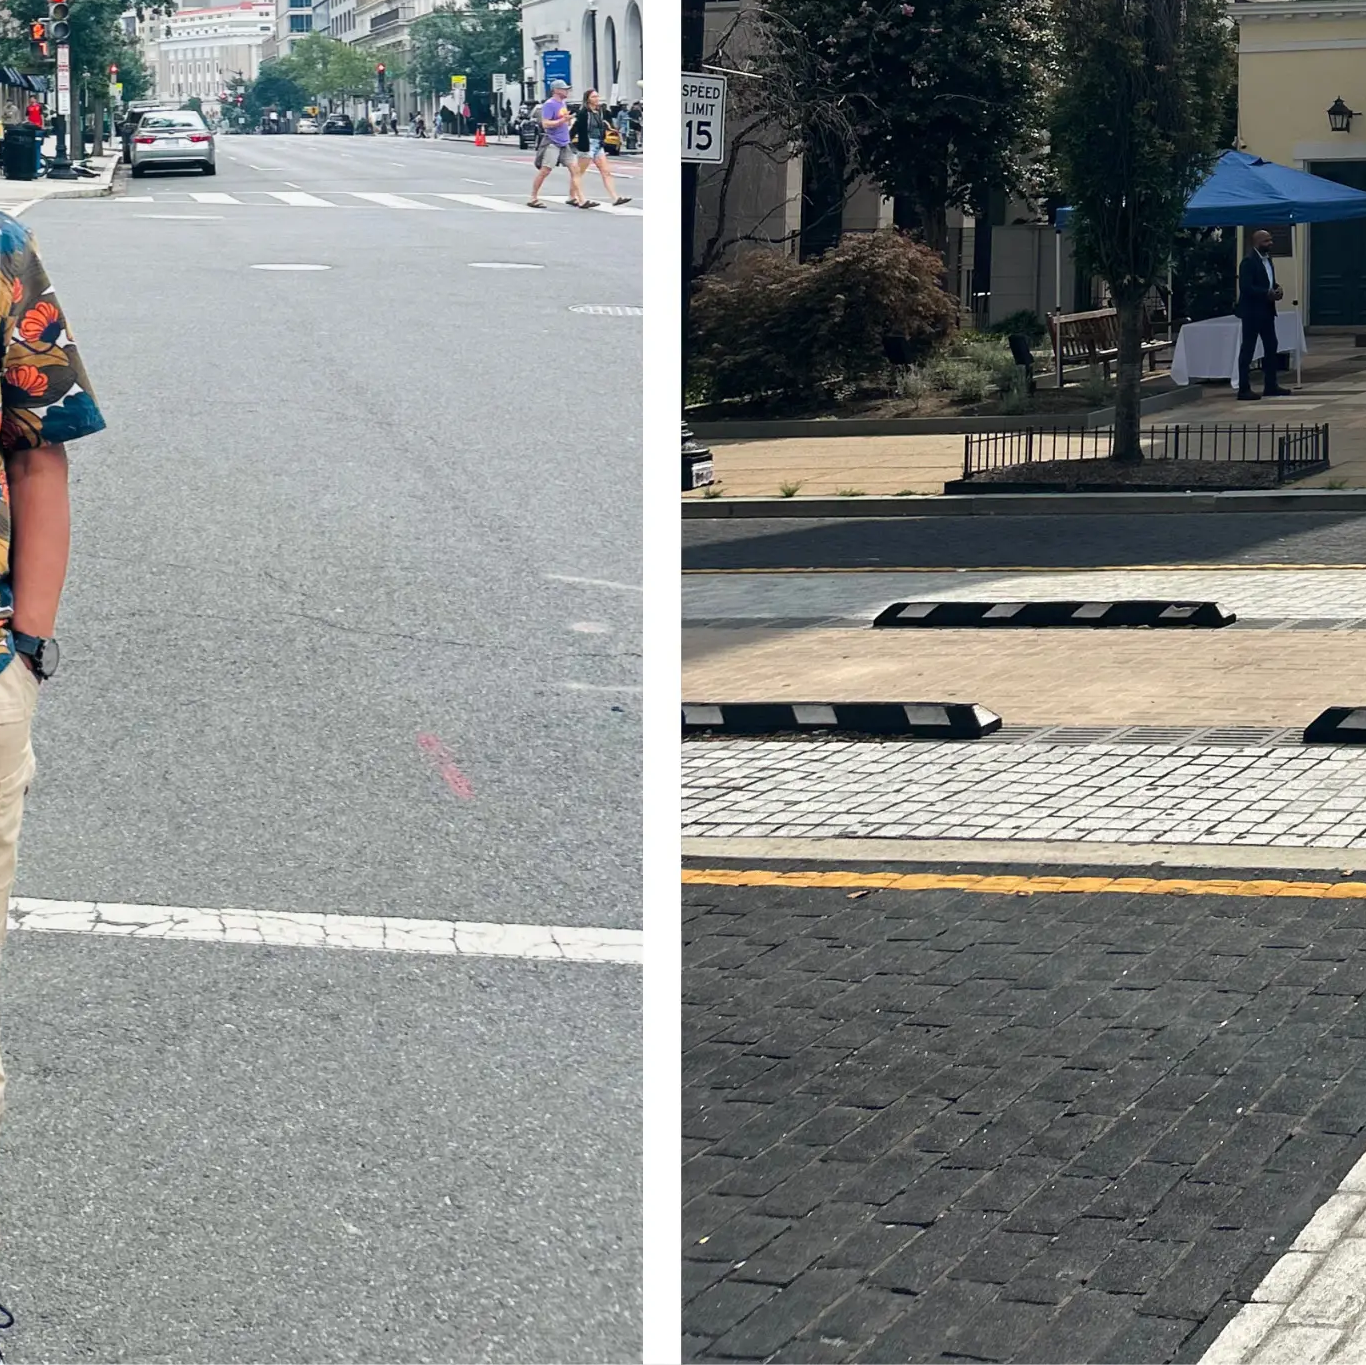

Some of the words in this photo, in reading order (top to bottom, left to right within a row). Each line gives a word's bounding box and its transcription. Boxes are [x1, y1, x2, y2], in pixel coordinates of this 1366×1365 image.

[682, 84, 721, 100] SPEED
[684, 101, 716, 117] LIMIT
[685, 119, 713, 151] 15
